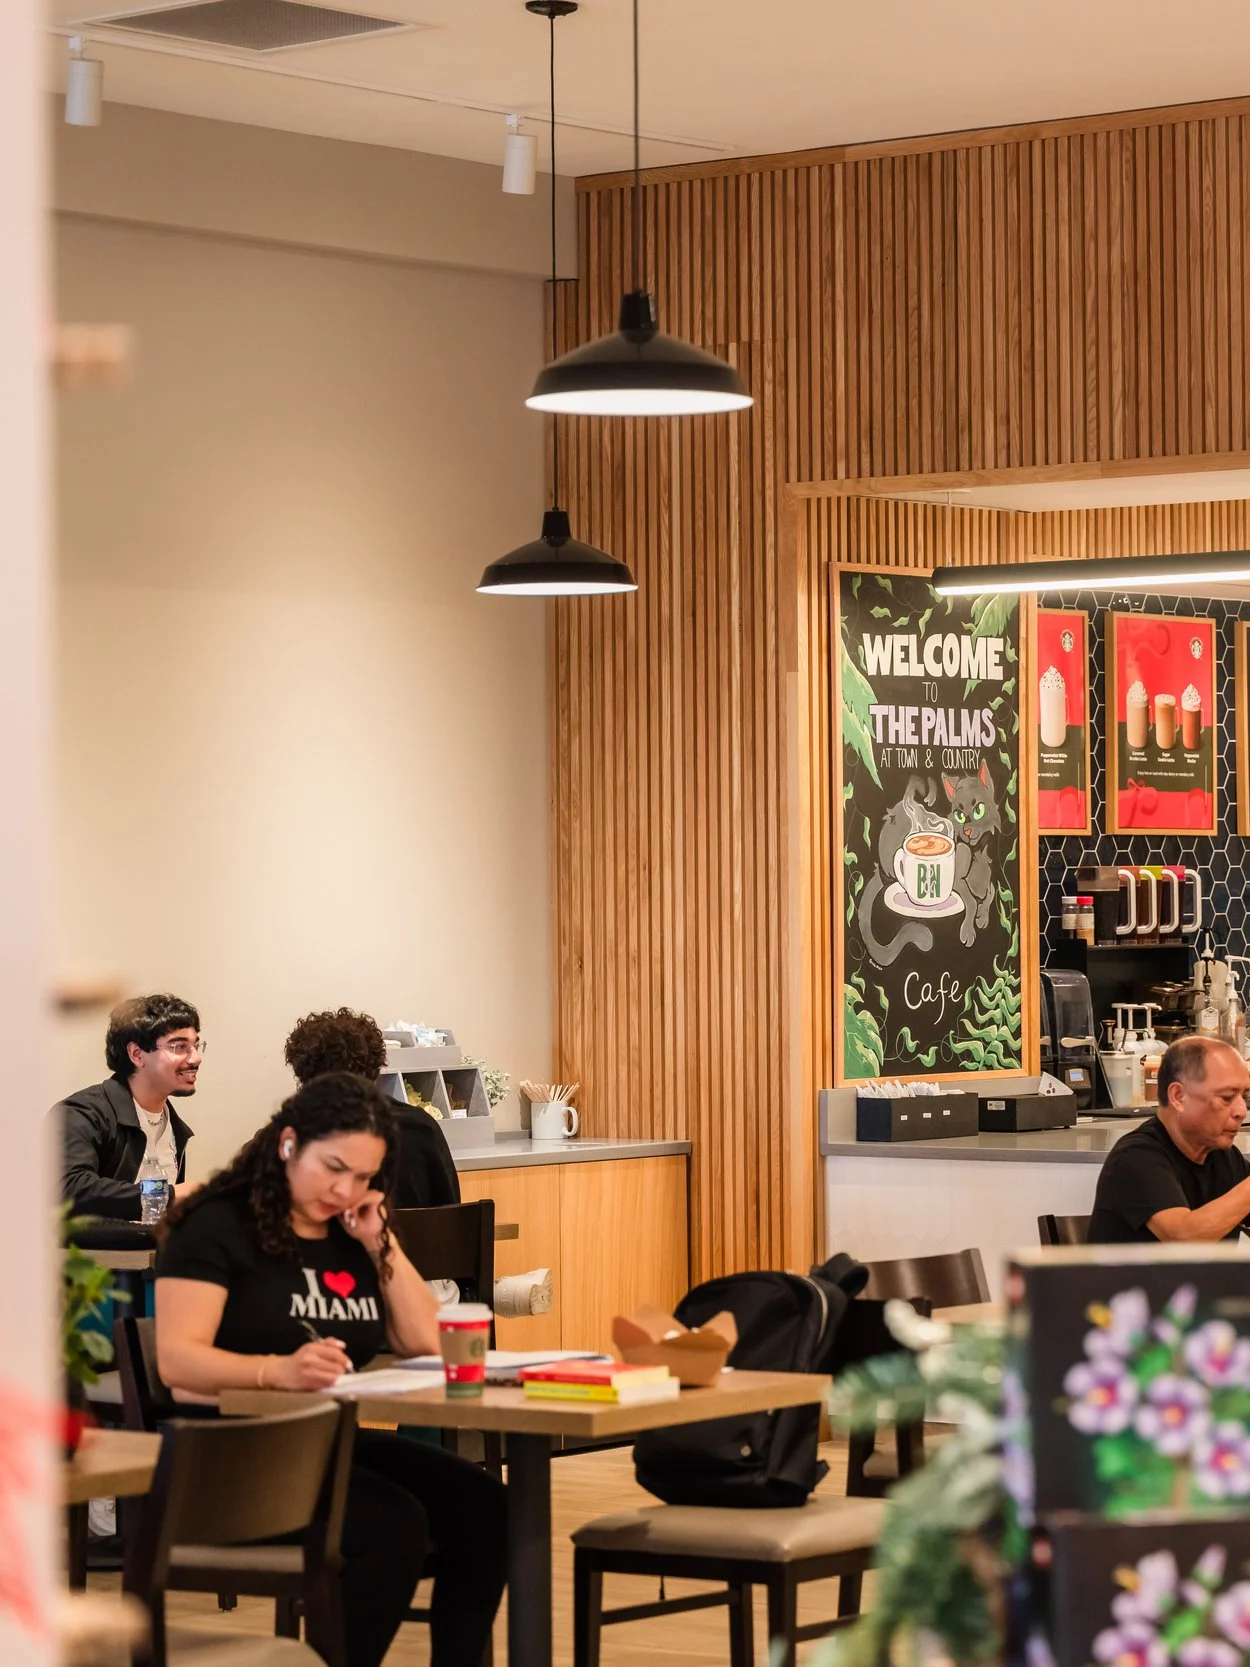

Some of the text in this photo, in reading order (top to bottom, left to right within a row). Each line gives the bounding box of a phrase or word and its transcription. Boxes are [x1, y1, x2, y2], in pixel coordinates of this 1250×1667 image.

[862, 632, 1004, 681] WELCOME
[922, 681, 939, 703] TO
[869, 704, 996, 748] THE PALMS
[880, 748, 981, 770] AT TOWN & COUNTRY
[904, 971, 963, 1026] Cafe
[302, 1267, 322, 1301] I
[289, 1292, 380, 1321] MIAMI
